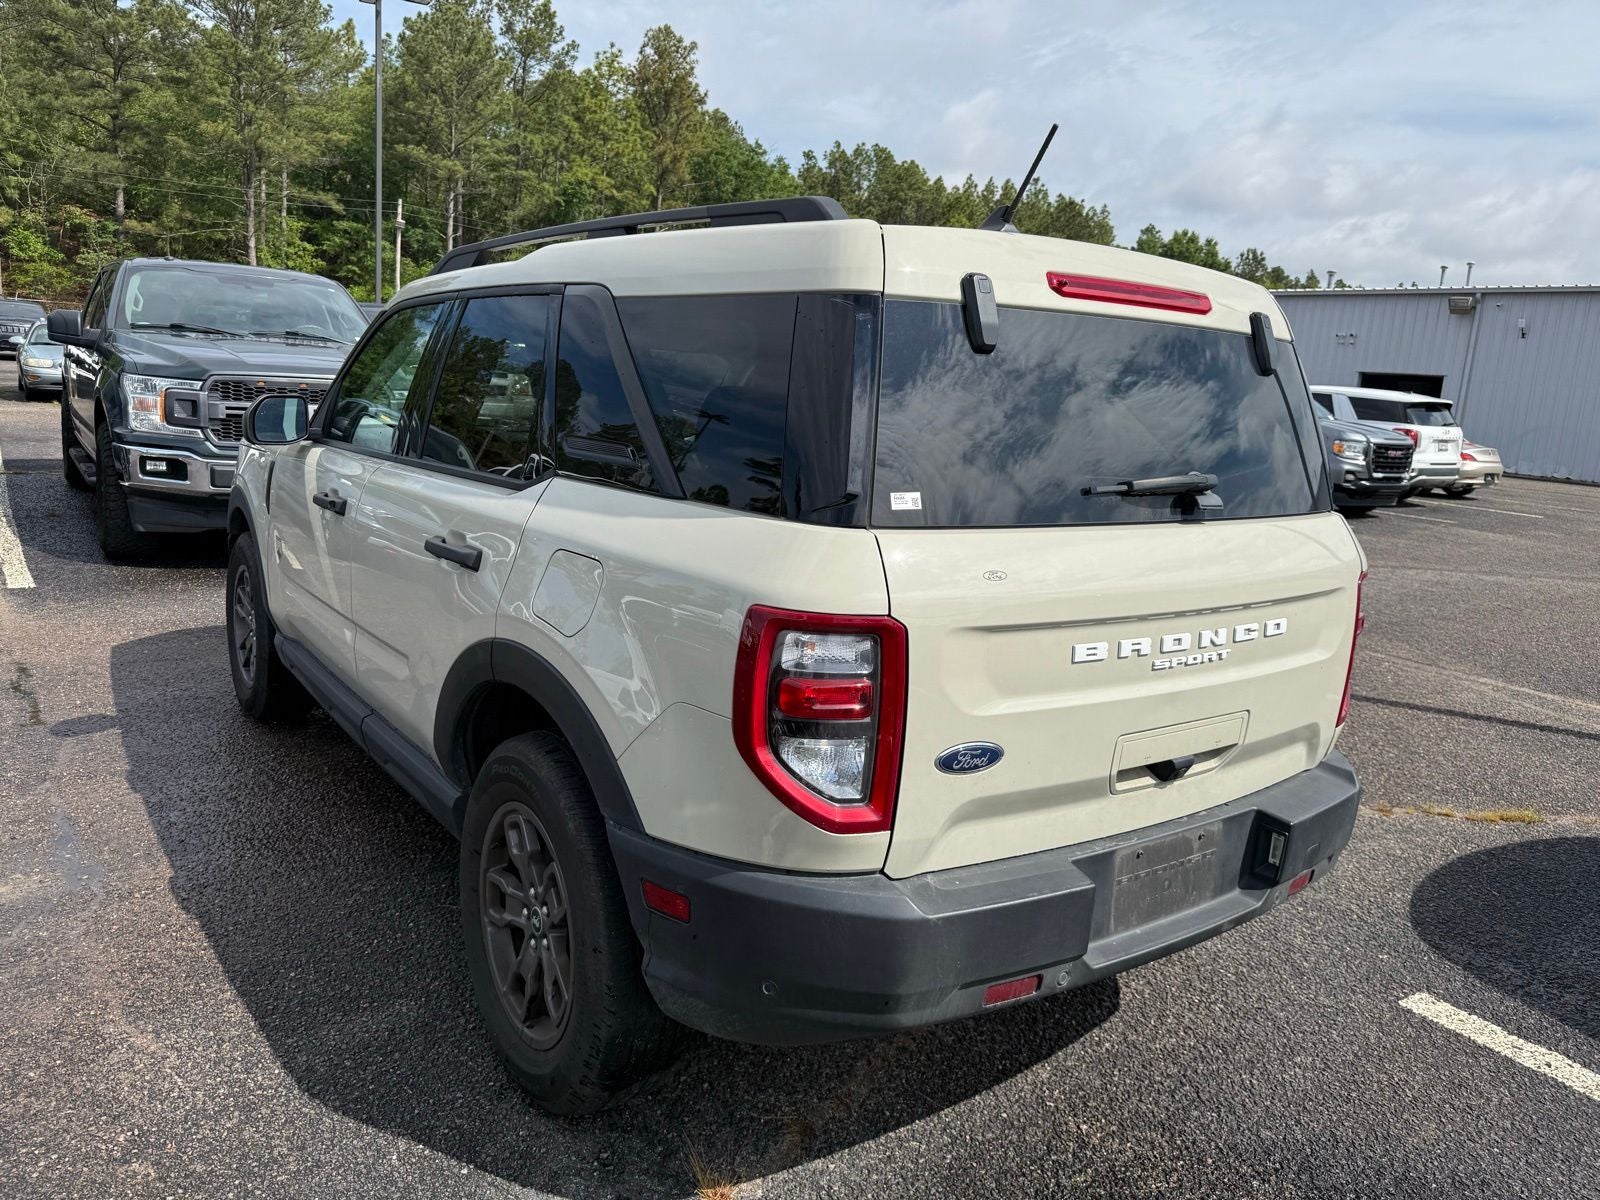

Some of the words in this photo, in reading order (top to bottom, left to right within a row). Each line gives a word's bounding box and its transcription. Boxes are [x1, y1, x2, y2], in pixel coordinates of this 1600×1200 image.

[1071, 617, 1288, 665] BRONCO
[1151, 649, 1232, 672] SPORT
[952, 749, 991, 770] Ford
[1115, 848, 1217, 887] BRONCO
